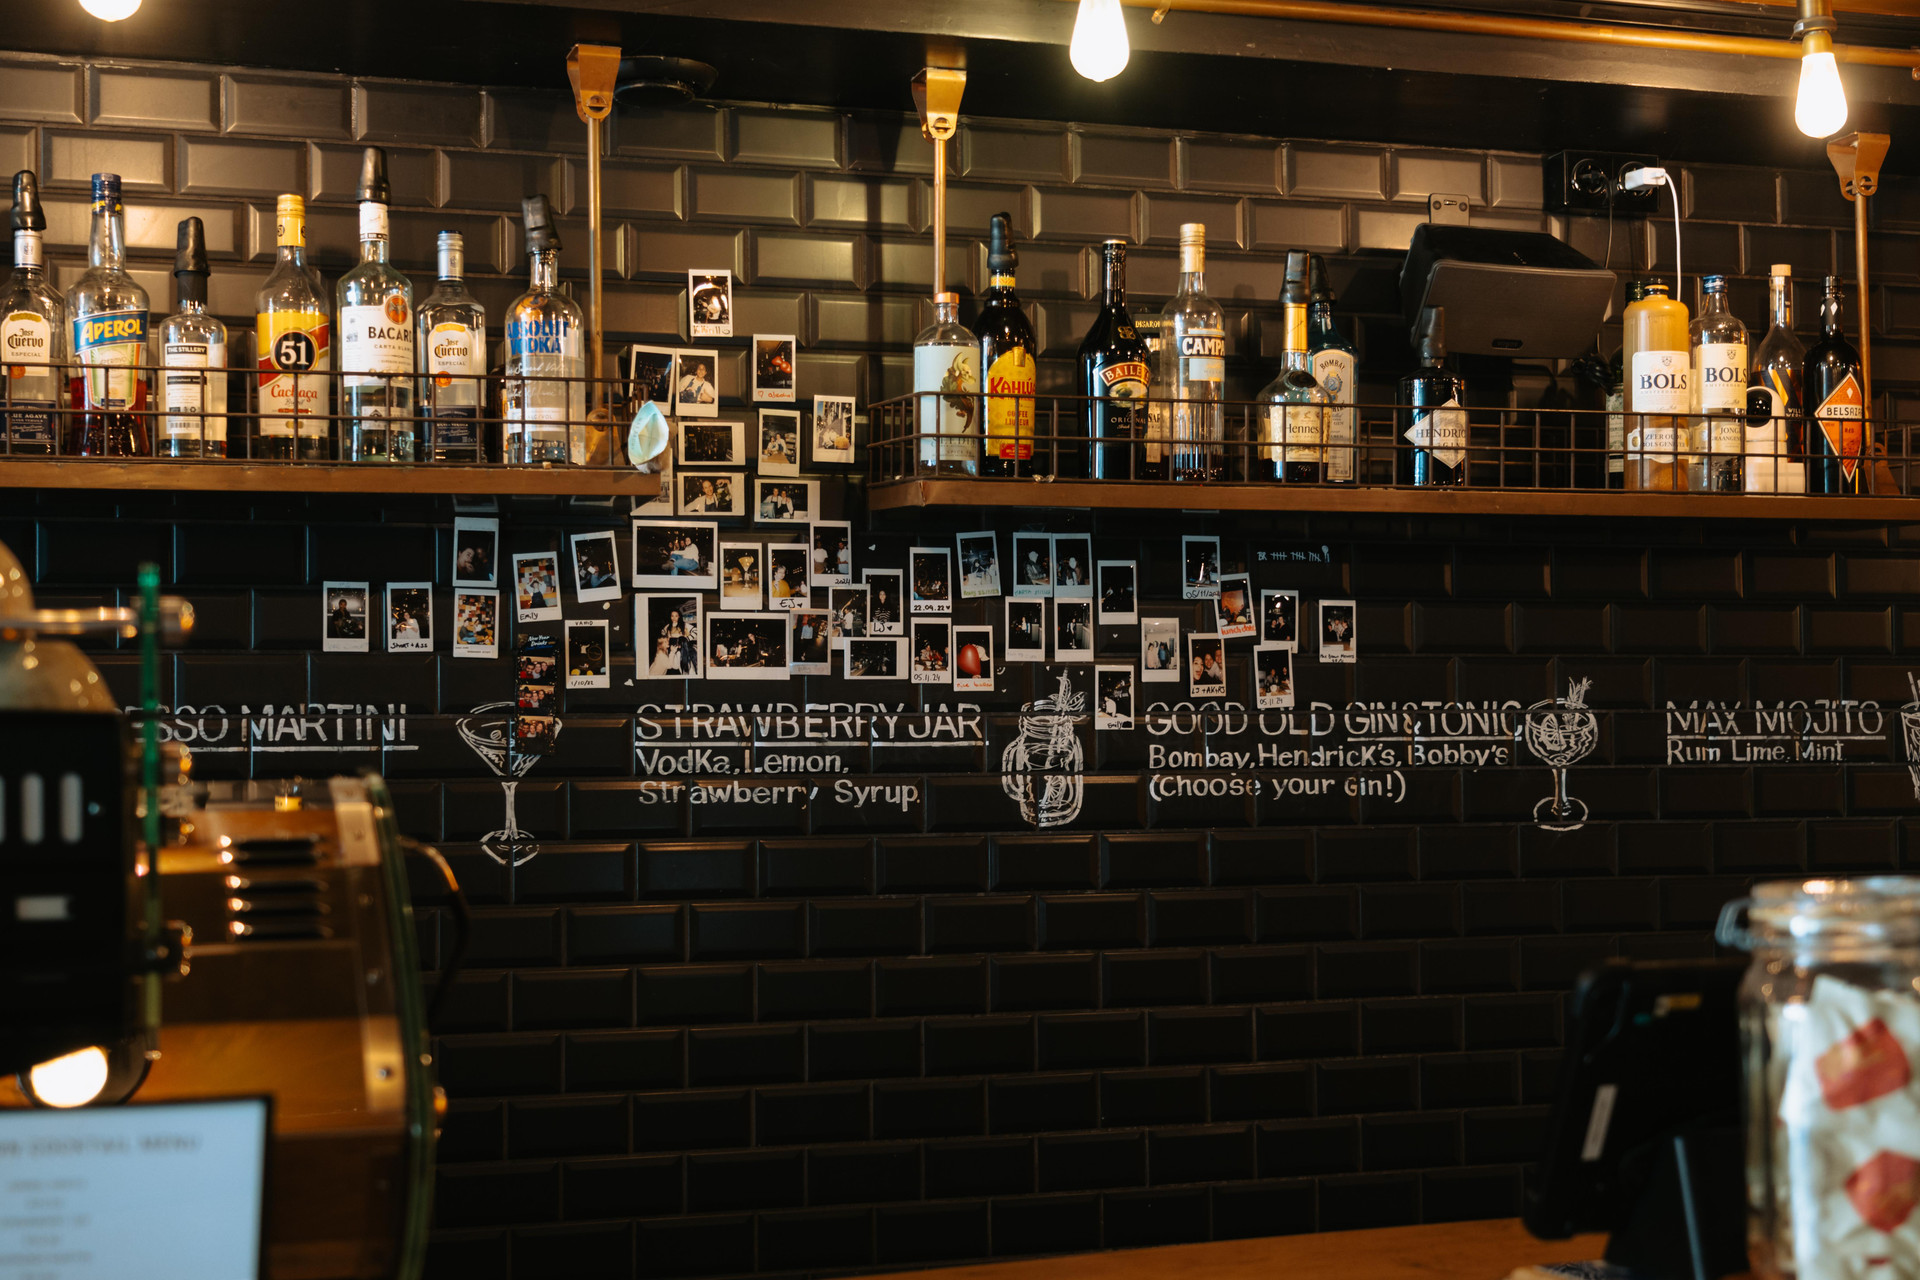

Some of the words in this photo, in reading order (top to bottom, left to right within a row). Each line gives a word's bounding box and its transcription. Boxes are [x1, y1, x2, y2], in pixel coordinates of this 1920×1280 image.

[20, 328, 34, 337] Jose
[80, 318, 142, 346] APEROL
[507, 320, 568, 339] ABSOLUT
[8, 333, 44, 349] Cuervo
[445, 338, 459, 346] Jose
[510, 337, 562, 355] VODKA
[280, 341, 309, 365] 51
[434, 344, 468, 358] Cuervo
[1320, 359, 1345, 369] BOMBAY
[1640, 374, 1687, 390] BOLS
[1705, 367, 1747, 383] BOLS
[520, 612, 538, 621] Emily
[242, 703, 406, 742] MARTINI
[636, 703, 904, 739] STRAWBERRY
[909, 703, 983, 739] JAR
[1145, 702, 1248, 735] GOOD
[1259, 702, 1335, 736] OLD
[1666, 700, 1741, 734] MAX
[1755, 699, 1883, 734] MOJITO
[1667, 739, 1721, 765] Rum
[638, 779, 819, 811] Strawberry
[1150, 773, 1261, 802] (Choose
[1272, 777, 1336, 800] your
[1344, 770, 1406, 802] Gin!)
